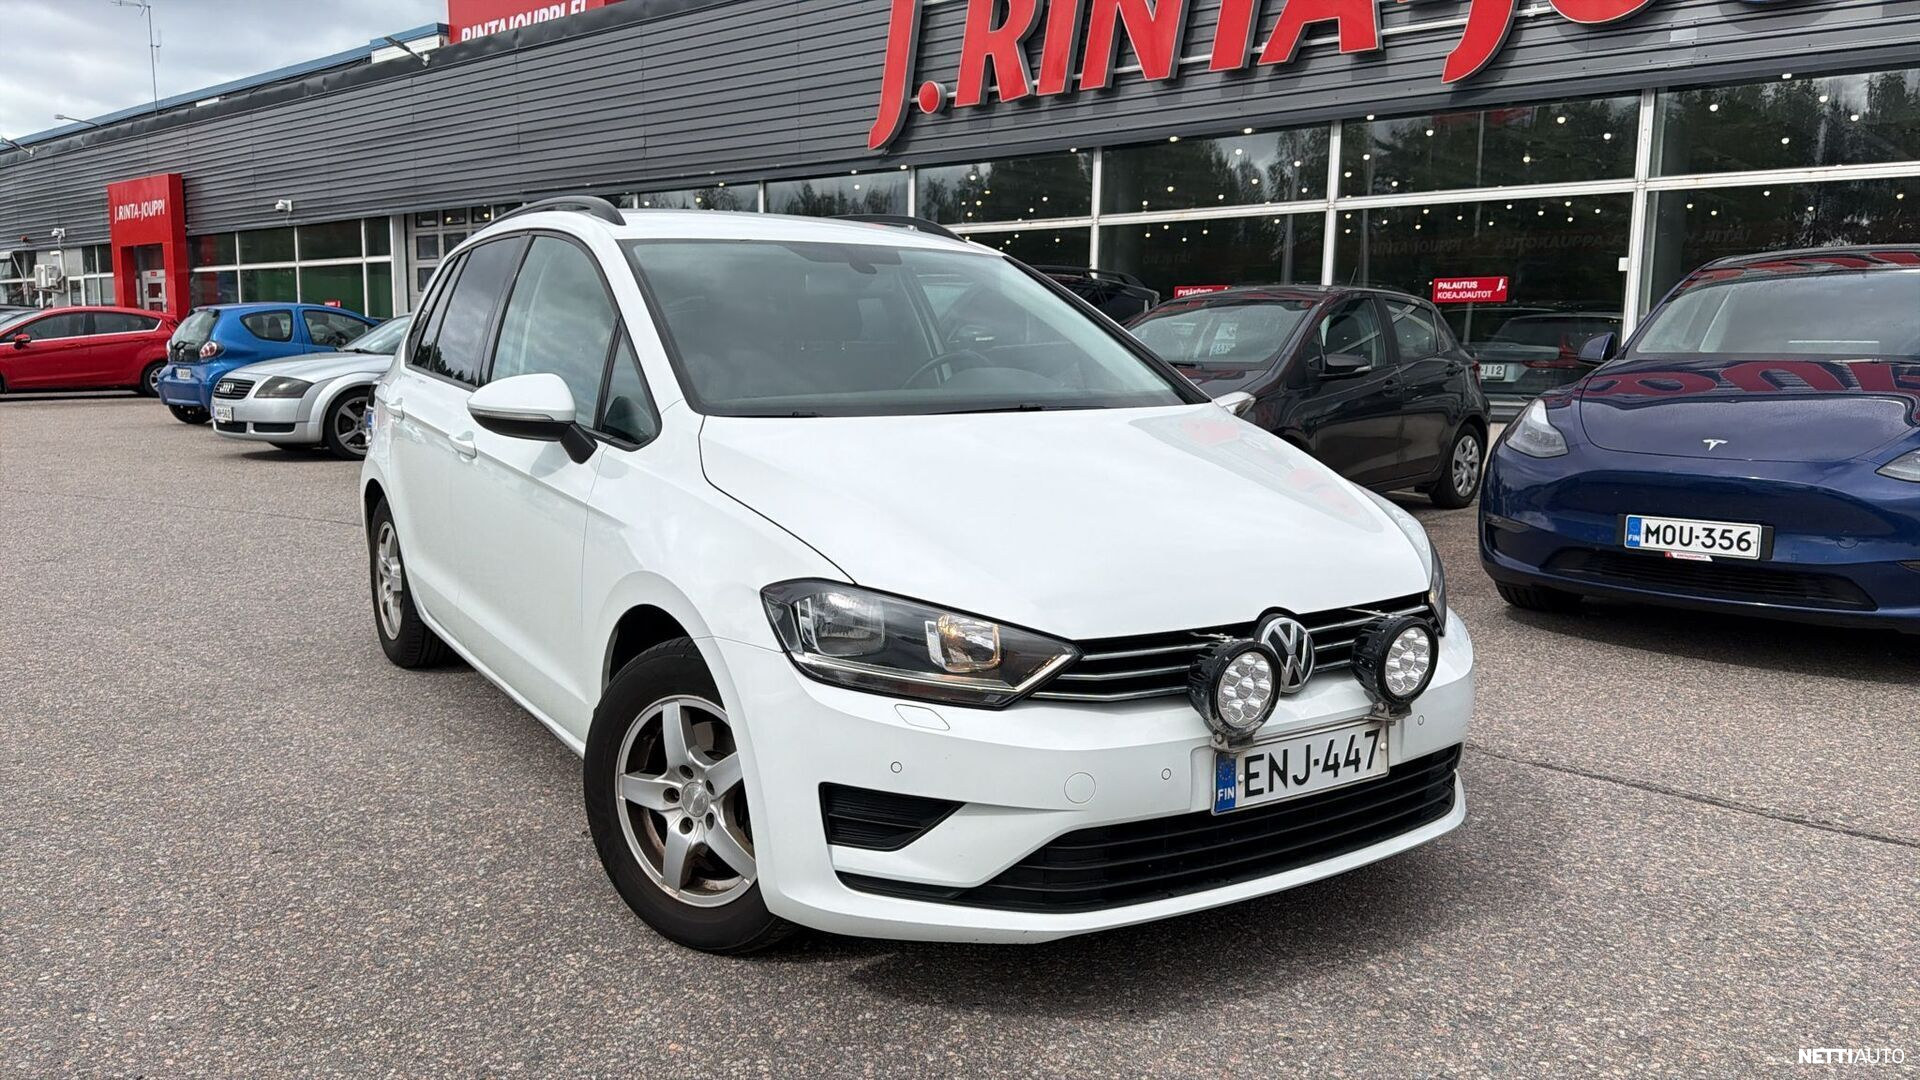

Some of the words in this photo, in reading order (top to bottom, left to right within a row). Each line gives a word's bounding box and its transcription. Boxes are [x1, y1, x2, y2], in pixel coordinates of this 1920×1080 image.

[114, 199, 166, 224] J.RINTA-JOUPPI
[1437, 281, 1478, 289] PALAUTUS
[1437, 290, 1493, 300] KOEAJOAUTOT
[1627, 534, 1640, 542] FIN
[1645, 523, 1752, 552] MOU-356
[1217, 786, 1235, 801] FIN
[1244, 728, 1381, 798] ENJ-447
